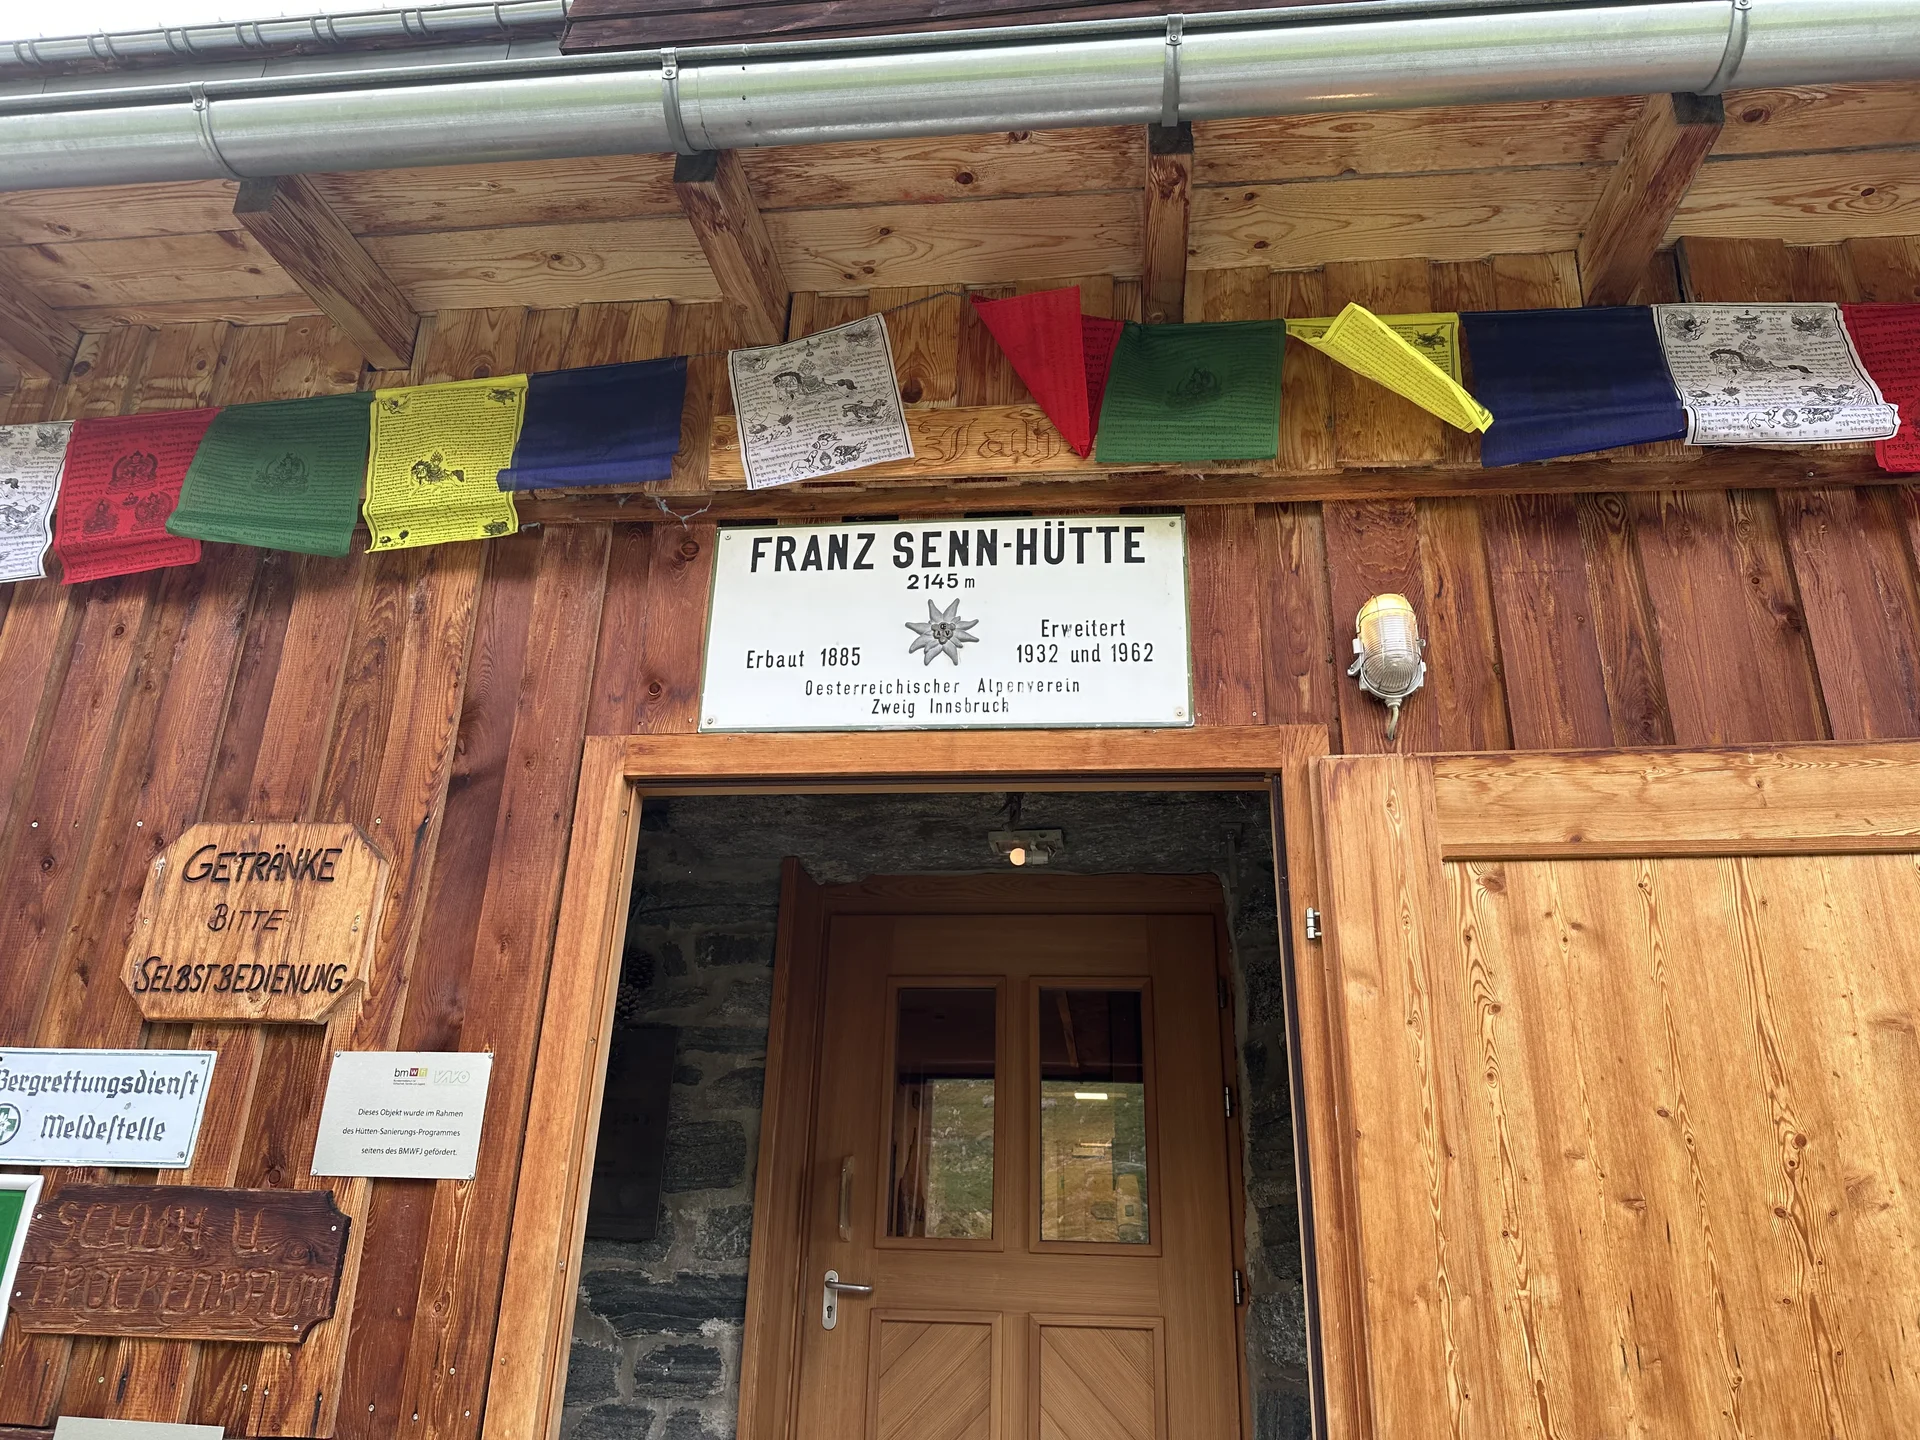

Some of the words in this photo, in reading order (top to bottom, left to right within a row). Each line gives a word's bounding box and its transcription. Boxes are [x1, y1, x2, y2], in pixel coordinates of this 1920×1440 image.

[750, 532, 876, 573] FRANZ
[892, 520, 1146, 569] SENN-HÜTTE
[906, 573, 959, 590] 2145
[964, 576, 976, 589] m
[1041, 619, 1126, 638] Erweitert
[746, 649, 805, 669] Erbaut
[820, 646, 861, 667] 1885
[1016, 643, 1059, 663] 1932
[1070, 643, 1101, 663] und
[1112, 642, 1154, 663] 1962
[805, 678, 960, 696] Oesterreichischer
[977, 677, 1081, 697] Alpenverein
[871, 698, 915, 718] Zweig
[929, 697, 1009, 714] Innsbruck
[182, 844, 342, 883] GETRÄNKE
[207, 903, 289, 932] BITTE
[134, 956, 347, 994] SELBSTBEDIENUNG
[358, 1108, 379, 1116] Dieses
[380, 1108, 402, 1118] Objekt
[403, 1109, 425, 1117] wurde
[425, 1109, 435, 1117] im
[435, 1109, 464, 1118] Rahmen
[342, 1127, 354, 1135] des
[355, 1127, 461, 1138] Hütten-Sanierungs-Programmes
[361, 1147, 384, 1155] seitens
[385, 1147, 398, 1155] des
[398, 1147, 423, 1156] BMWFJ
[424, 1147, 458, 1157] gefördert.
